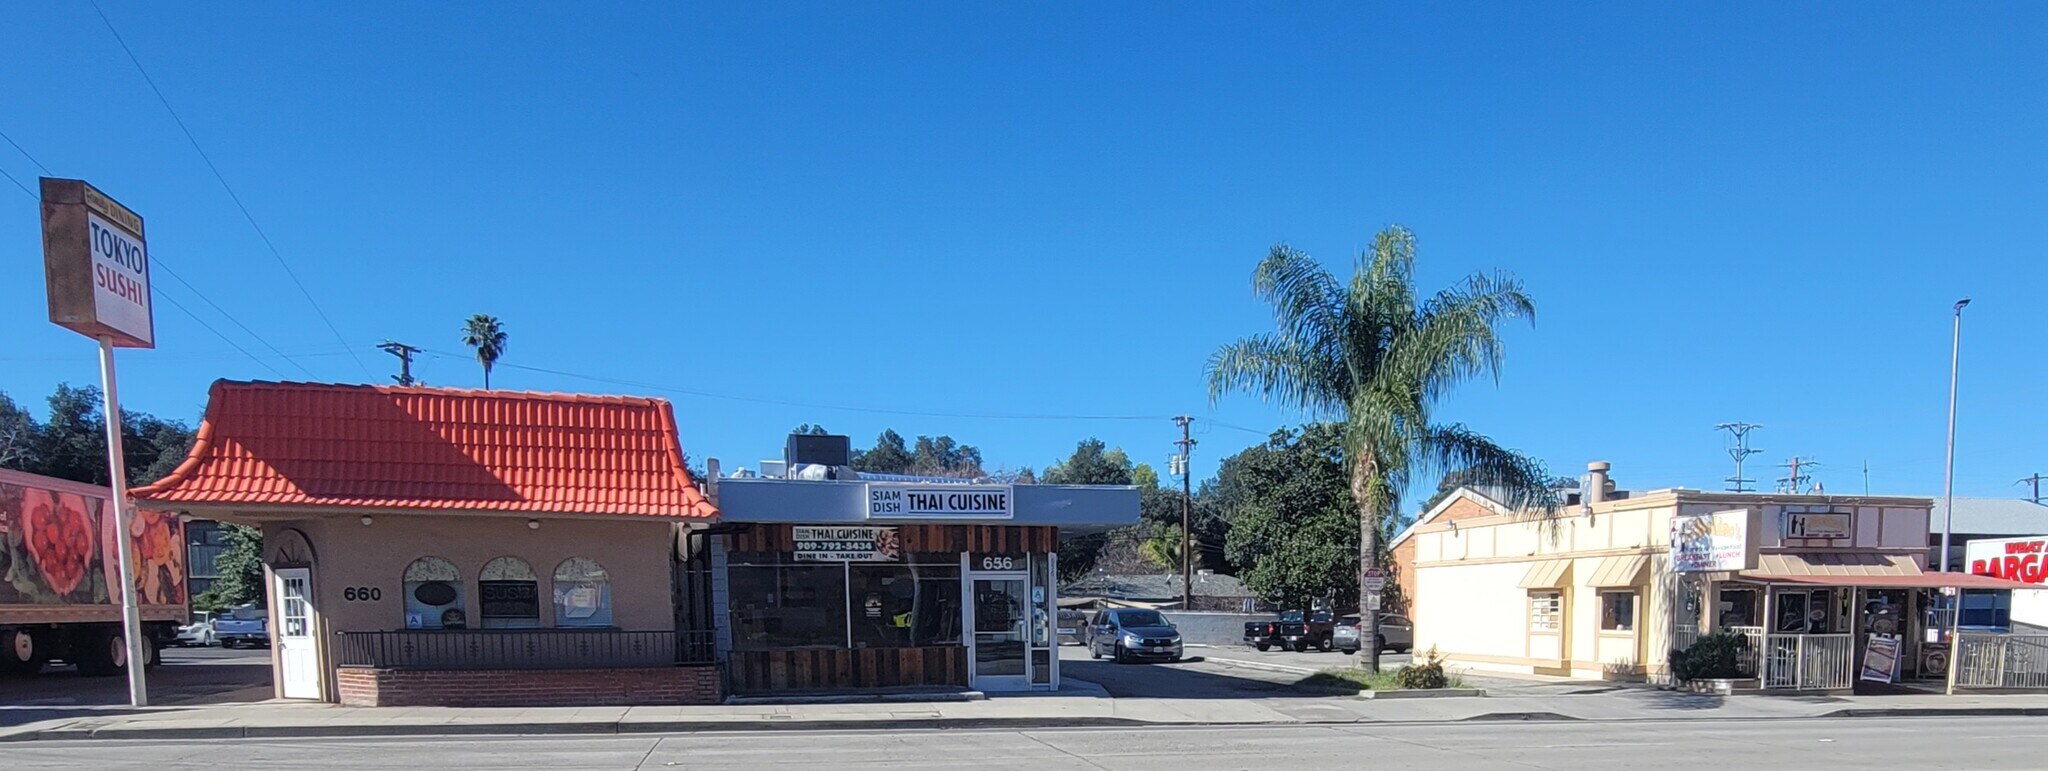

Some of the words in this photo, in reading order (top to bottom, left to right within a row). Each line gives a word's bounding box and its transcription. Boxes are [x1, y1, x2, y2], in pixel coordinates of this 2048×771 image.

[110, 202, 140, 234] DINING
[91, 221, 143, 275] TOKYO
[97, 263, 144, 307] SUSHI
[872, 491, 901, 501] SIAM
[907, 494, 943, 510] THAI
[948, 494, 1006, 510] CUISINE
[873, 502, 901, 512] DISH
[811, 529, 834, 539] THAI
[837, 529, 874, 539] CUISINE
[797, 542, 872, 550] 909-792-5434
[2005, 541, 2045, 554] WHAT
[983, 557, 1013, 570] 656
[344, 587, 381, 601] 660
[1035, 590, 1041, 599] A
[410, 616, 419, 624] A
